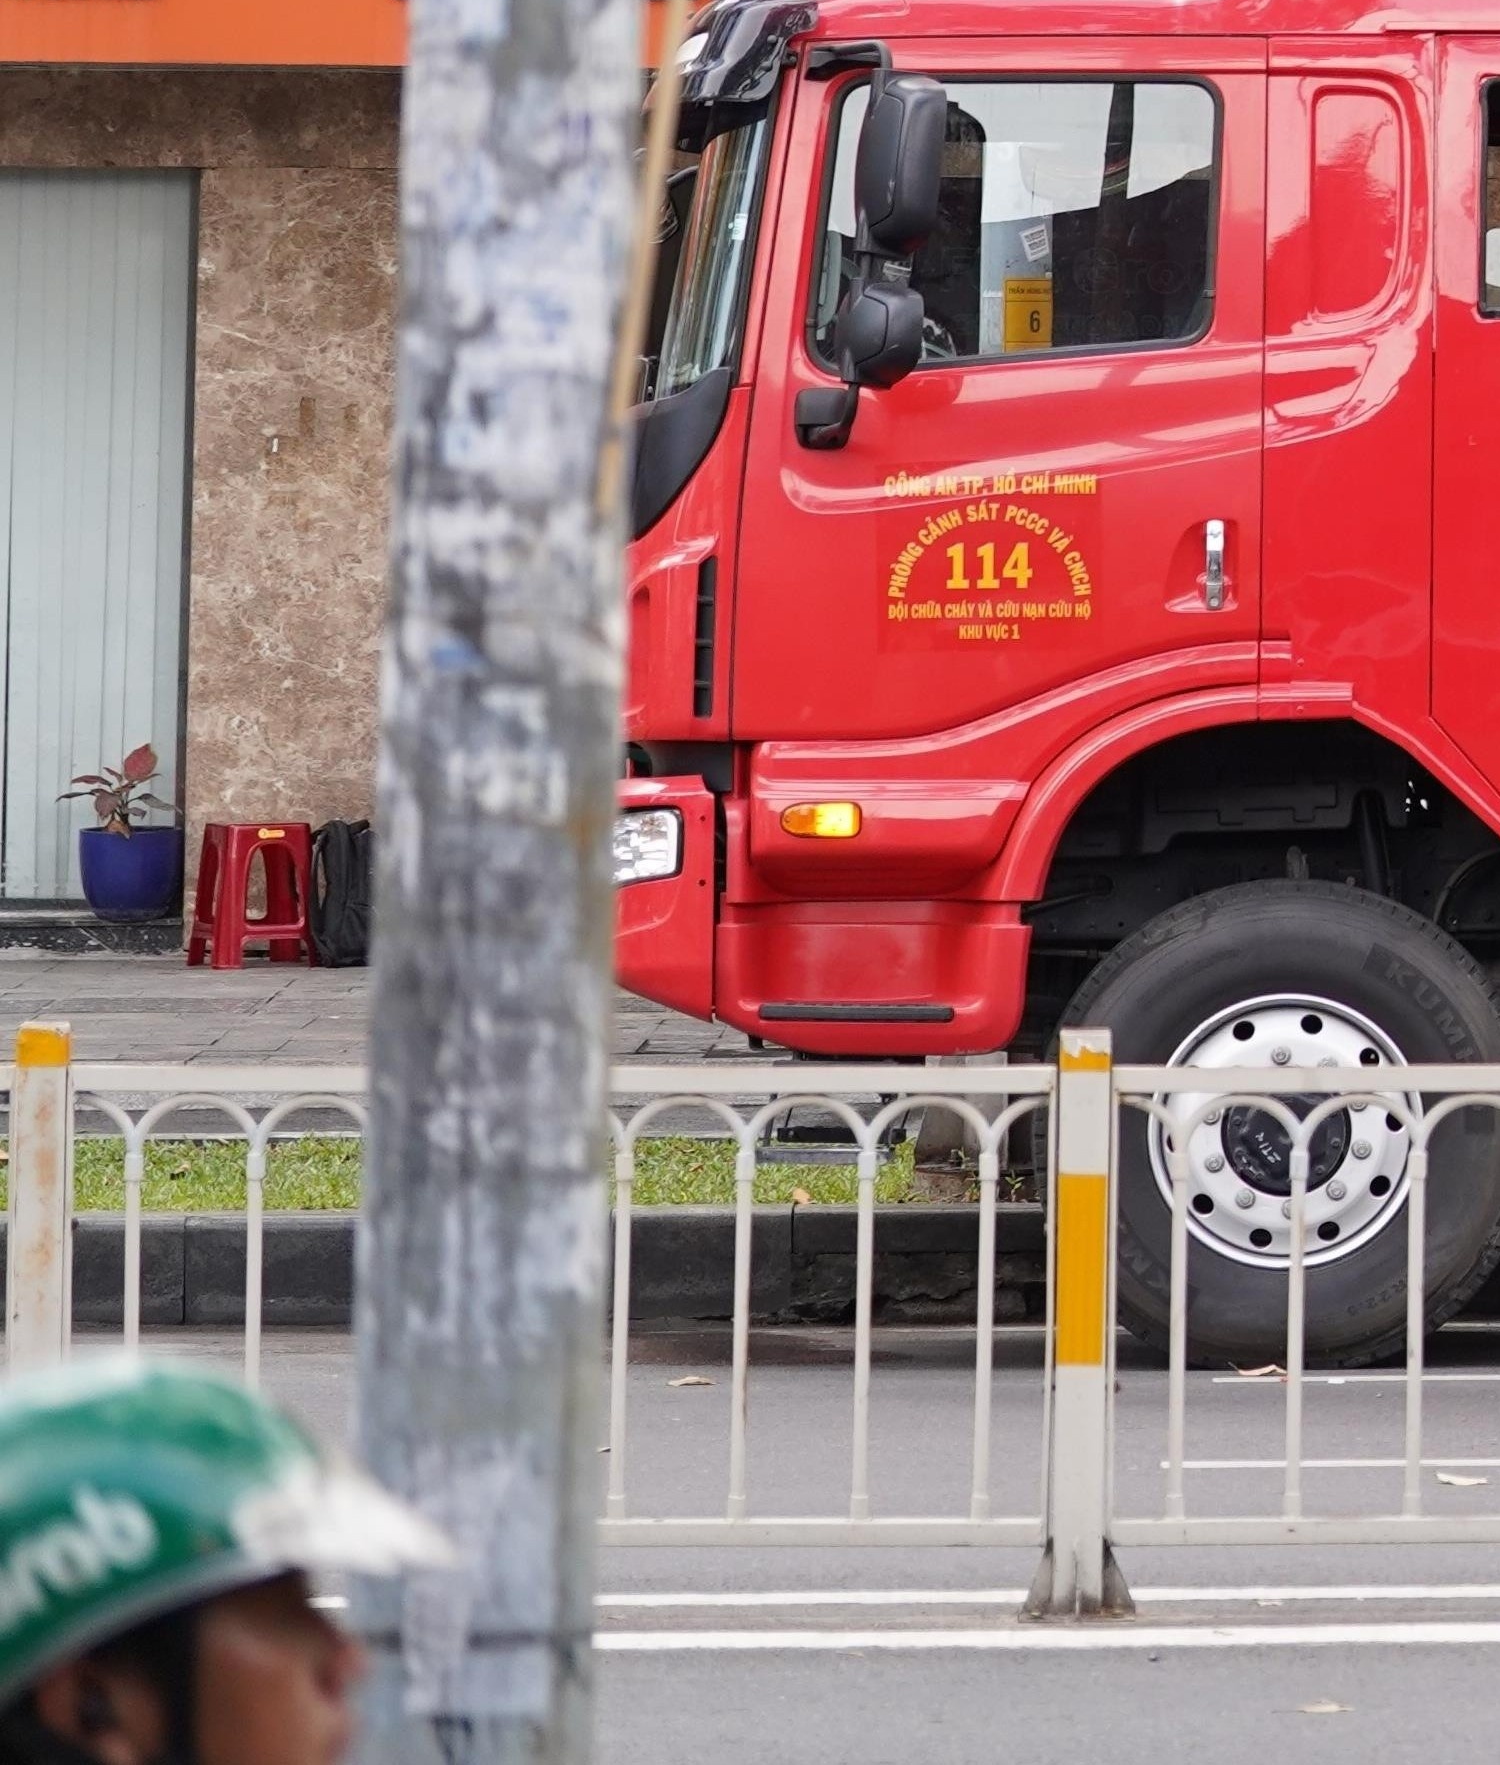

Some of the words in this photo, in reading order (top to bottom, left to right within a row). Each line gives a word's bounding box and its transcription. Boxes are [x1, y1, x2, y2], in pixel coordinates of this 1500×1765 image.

[1029, 309, 1041, 333] 6
[883, 471, 931, 497] CÔNG
[934, 475, 958, 495] AN
[962, 475, 988, 495] TP.
[993, 468, 1016, 495] HỒ
[1021, 470, 1049, 495] CHÍ
[1054, 473, 1097, 495] MINH
[887, 541, 925, 598] PHÒNG
[918, 509, 963, 545] CẢNH
[966, 498, 1000, 523] SÁT
[1004, 504, 1050, 535] PCCC
[1047, 527, 1074, 553] VÀ
[1063, 551, 1092, 596] CNCH
[946, 541, 1033, 590] 114
[888, 600, 909, 622] ĐỘI
[911, 600, 941, 619] CHỮA
[944, 599, 975, 619] CHÁY
[978, 599, 993, 619] VÀ
[996, 599, 1020, 619] CỨU
[1022, 603, 1046, 621] NẠN
[1048, 599, 1072, 619] CỨU
[1075, 598, 1092, 621] HỘ
[959, 624, 983, 640] KHU
[986, 622, 1008, 642] VỰC
[1011, 624, 1020, 639] 1
[0, 1478, 160, 1635] rab
